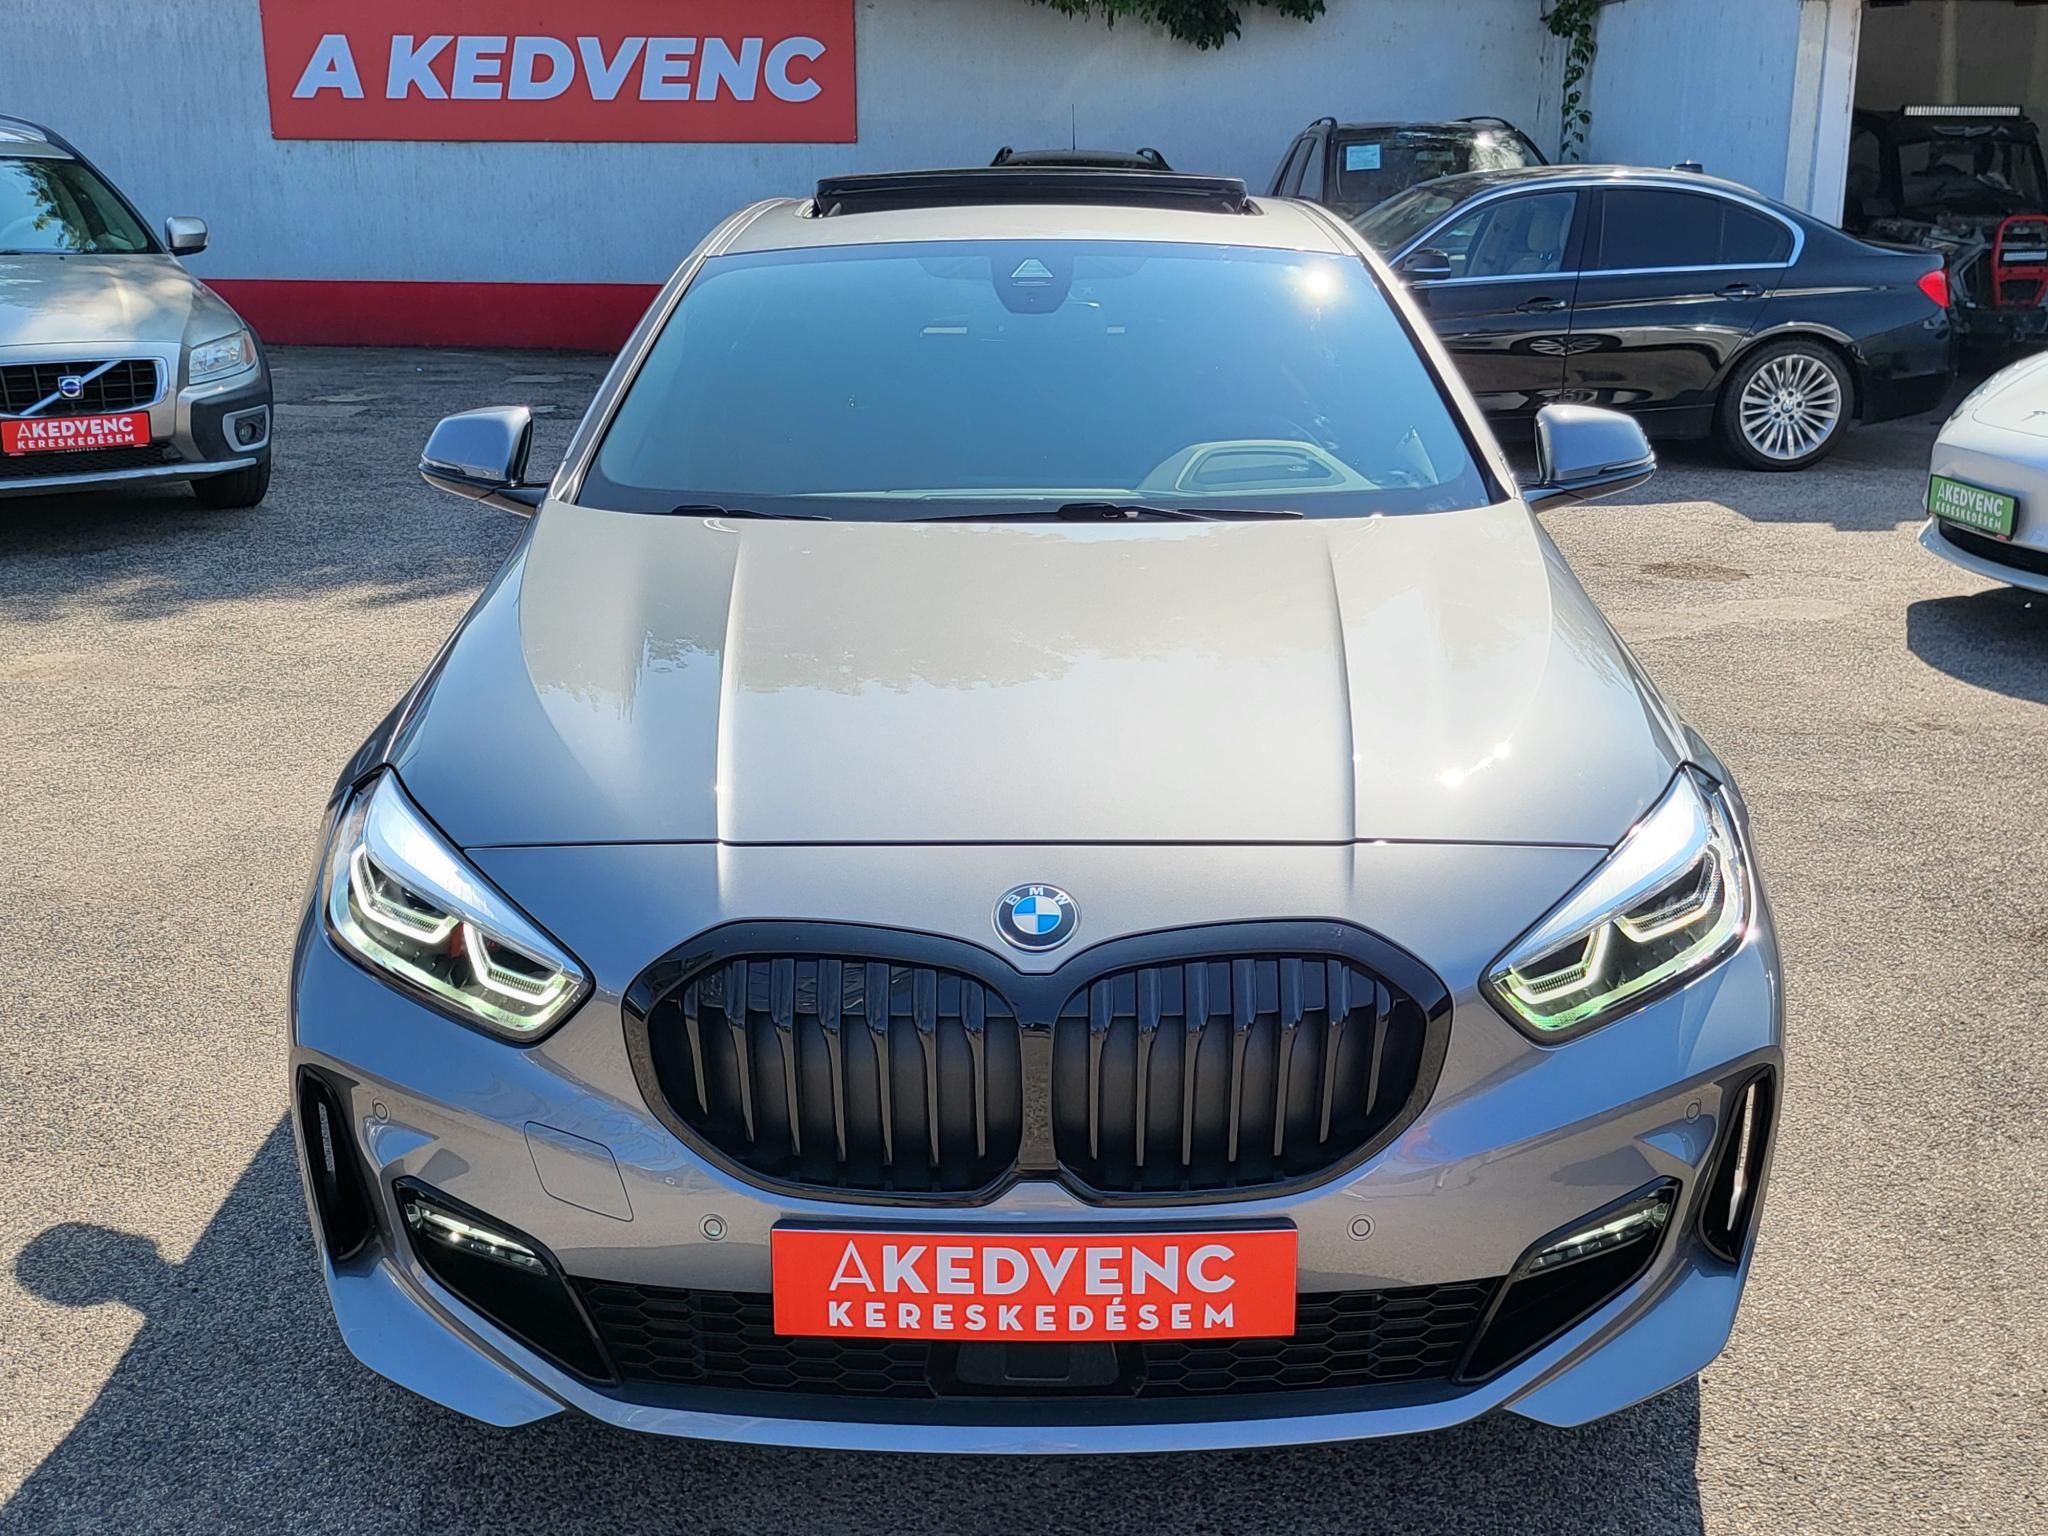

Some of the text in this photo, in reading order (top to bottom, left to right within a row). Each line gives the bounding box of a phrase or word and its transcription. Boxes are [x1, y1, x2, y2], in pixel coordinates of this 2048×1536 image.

[291, 33, 827, 102] A KEDVENC
[17, 433, 135, 449] KERESKEDÉSEM
[1005, 887, 1069, 906] BMW
[828, 1297, 1235, 1332] KERESKEDÉSEM
